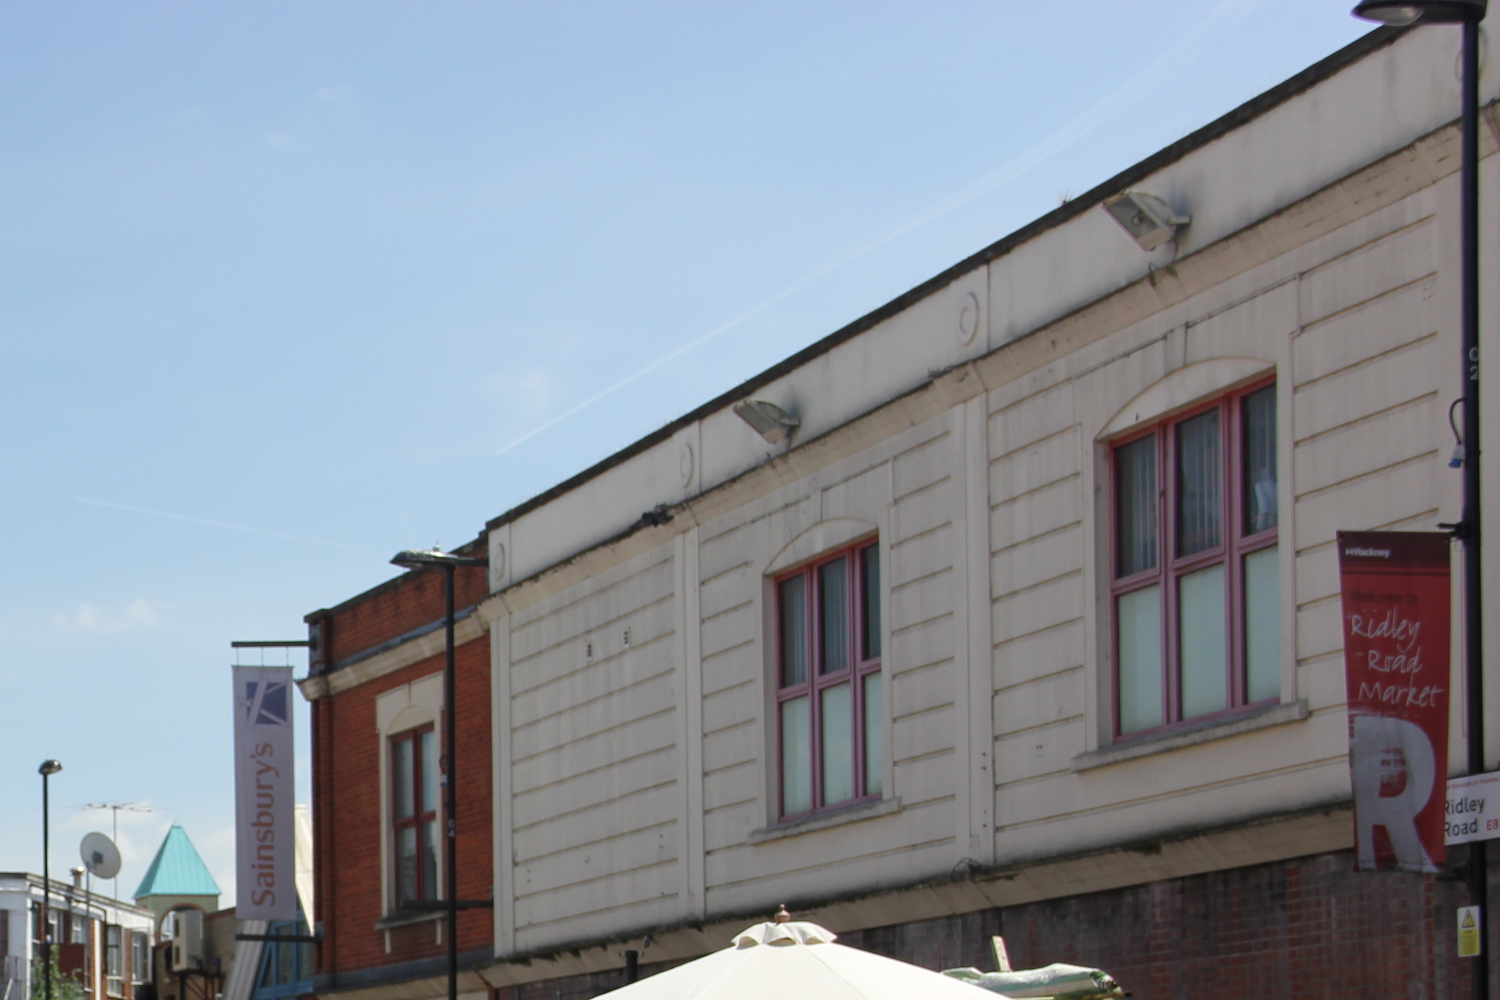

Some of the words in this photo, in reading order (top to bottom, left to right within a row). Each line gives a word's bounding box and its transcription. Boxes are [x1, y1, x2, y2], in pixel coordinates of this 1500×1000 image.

[1354, 548, 1391, 559] Hackney
[1350, 607, 1421, 653] Ridley
[1367, 644, 1423, 674] Road
[1358, 672, 1444, 708] Market
[1353, 715, 1445, 873] R
[1445, 796, 1485, 816] Ridley
[250, 742, 280, 908] Sainsbury's
[1444, 816, 1479, 838] Road
[1485, 818, 1499, 832] E8
